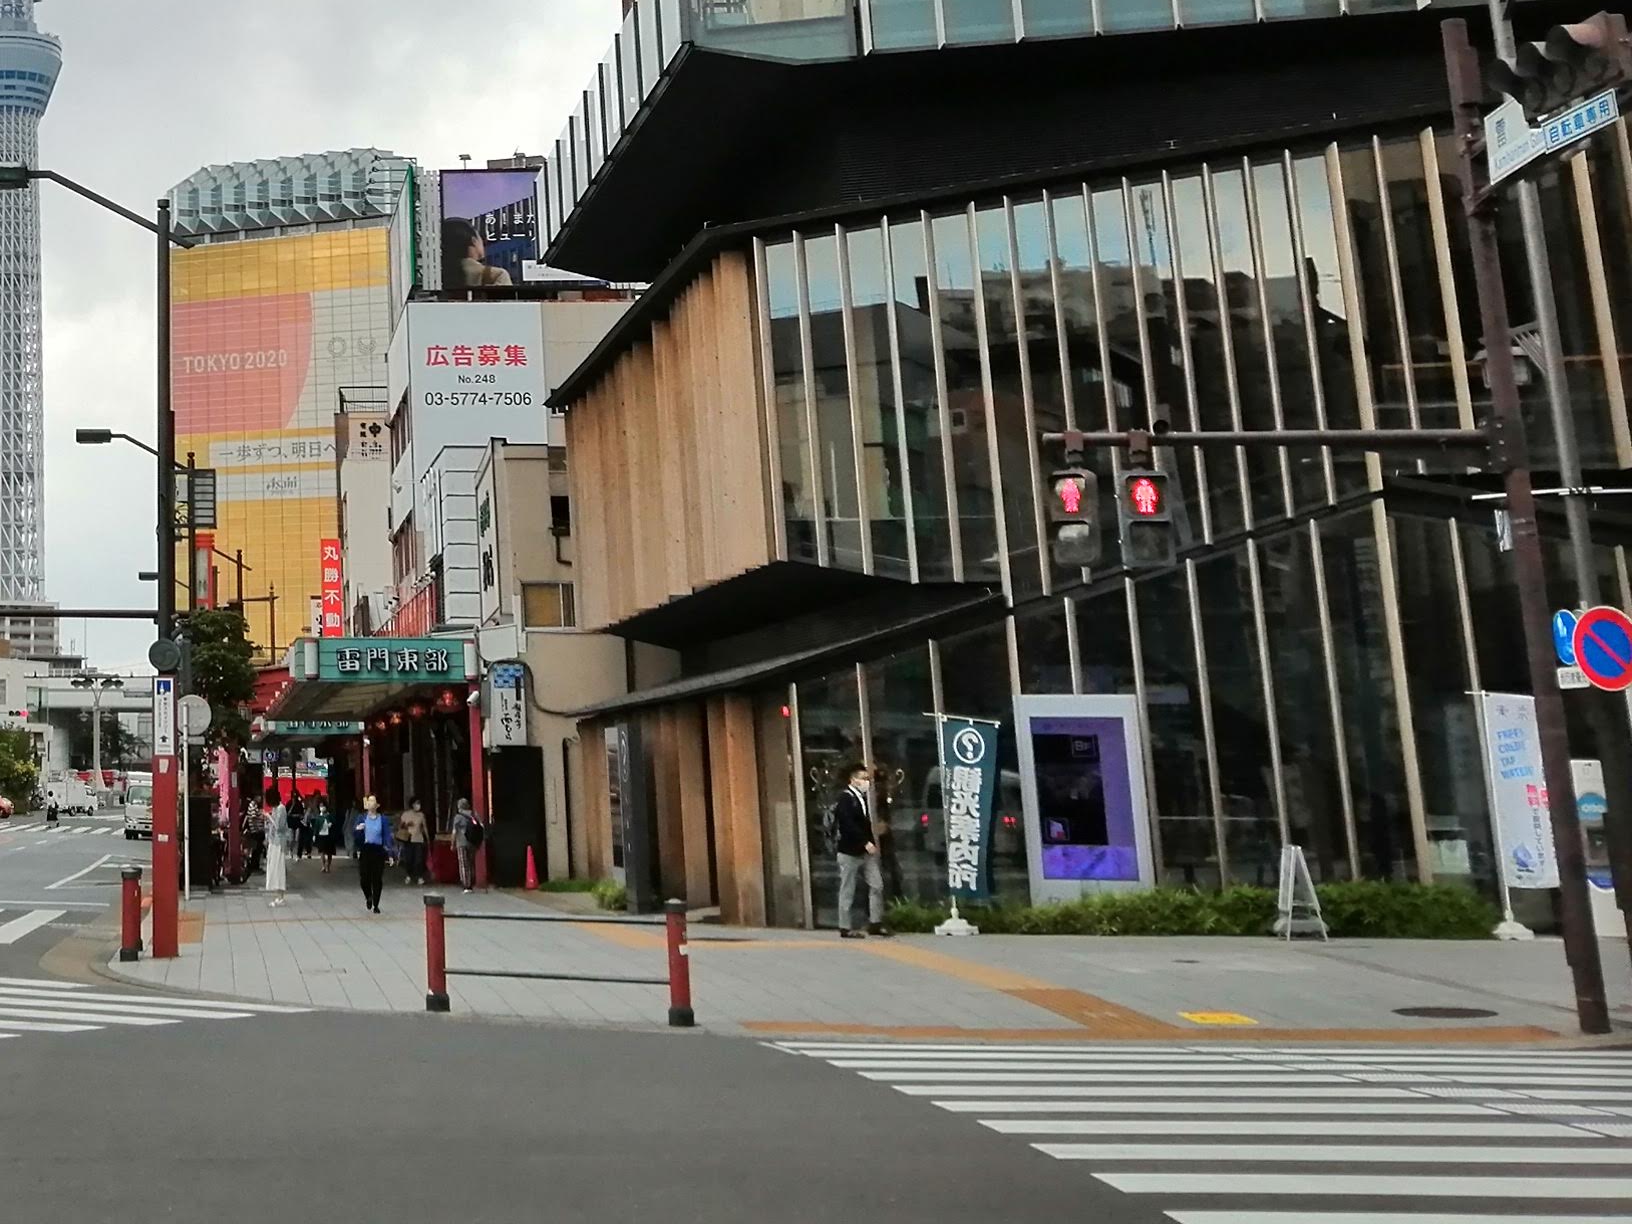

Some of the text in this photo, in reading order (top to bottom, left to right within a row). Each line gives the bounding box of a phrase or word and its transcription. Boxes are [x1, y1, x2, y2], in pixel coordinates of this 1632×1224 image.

[183, 348, 288, 374] TOKYO 2020
[425, 344, 528, 367] 広告募集
[457, 374, 496, 385] No.248
[424, 390, 532, 407] 03-5774-7506
[219, 441, 337, 462] 一歩ずつ、明日へ
[322, 545, 341, 638] 丸勝不動
[336, 647, 449, 673] 雷門東部
